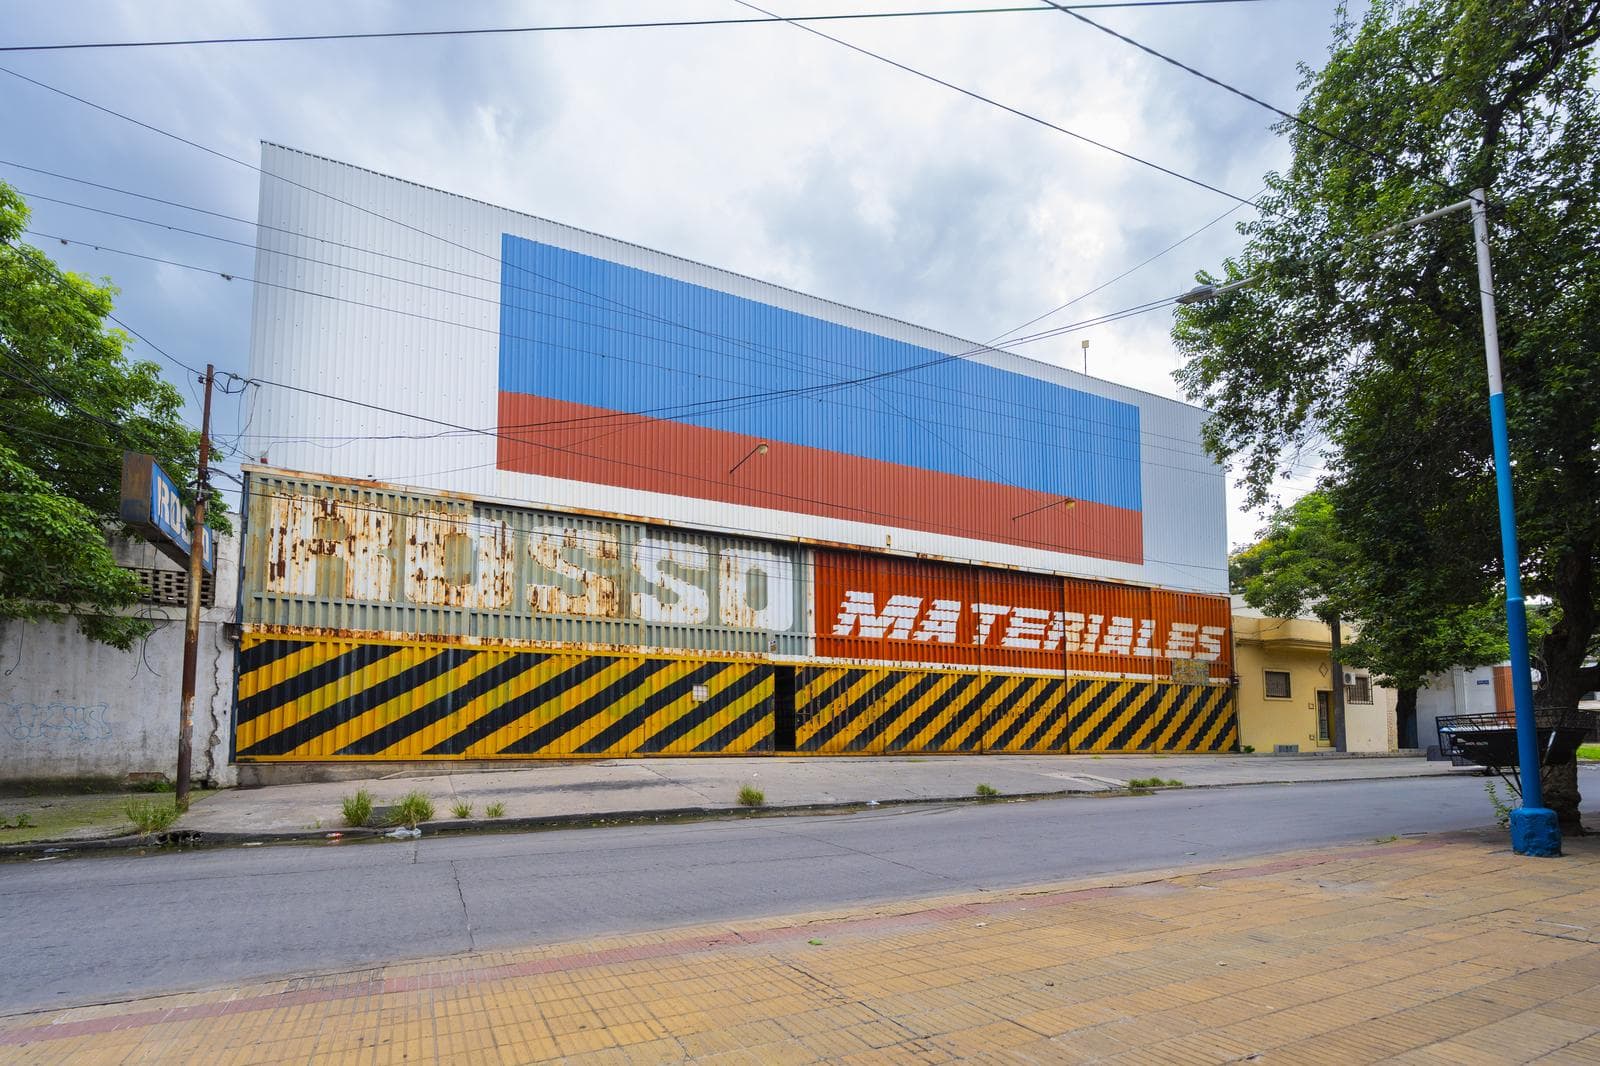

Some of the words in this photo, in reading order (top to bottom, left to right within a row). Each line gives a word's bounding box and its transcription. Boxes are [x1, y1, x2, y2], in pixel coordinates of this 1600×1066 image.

[157, 476, 209, 562] ROSO
[266, 492, 793, 630] ROSSO
[832, 590, 1226, 661] MATERIALES
